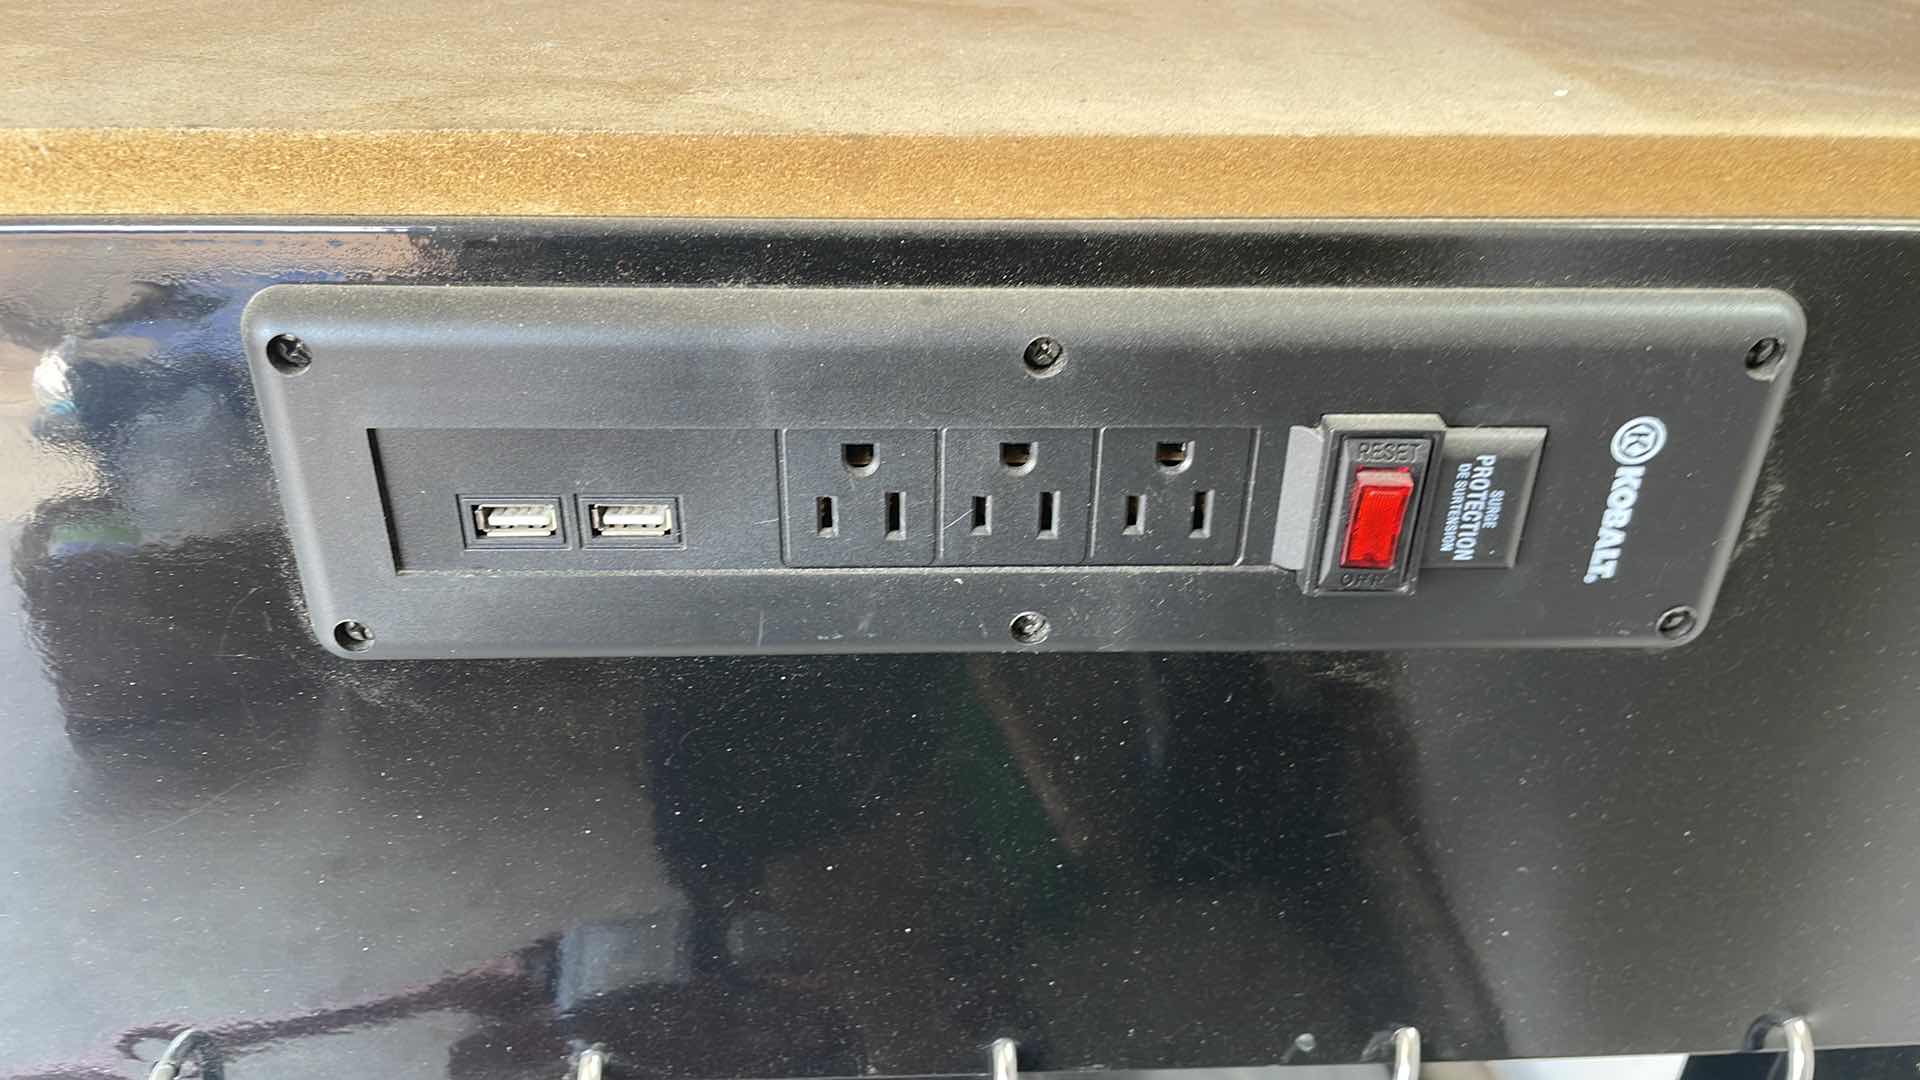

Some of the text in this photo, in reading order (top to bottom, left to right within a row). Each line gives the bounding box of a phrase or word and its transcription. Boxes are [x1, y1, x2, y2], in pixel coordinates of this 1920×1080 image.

[1358, 441, 1424, 463] RESET
[1439, 463, 1473, 552] DE SURTENSION
[1452, 454, 1497, 561] PROTECTION
[1482, 489, 1505, 529] SURGE
[1586, 466, 1647, 579] KOBALT
[1339, 573, 1388, 589] OFF
